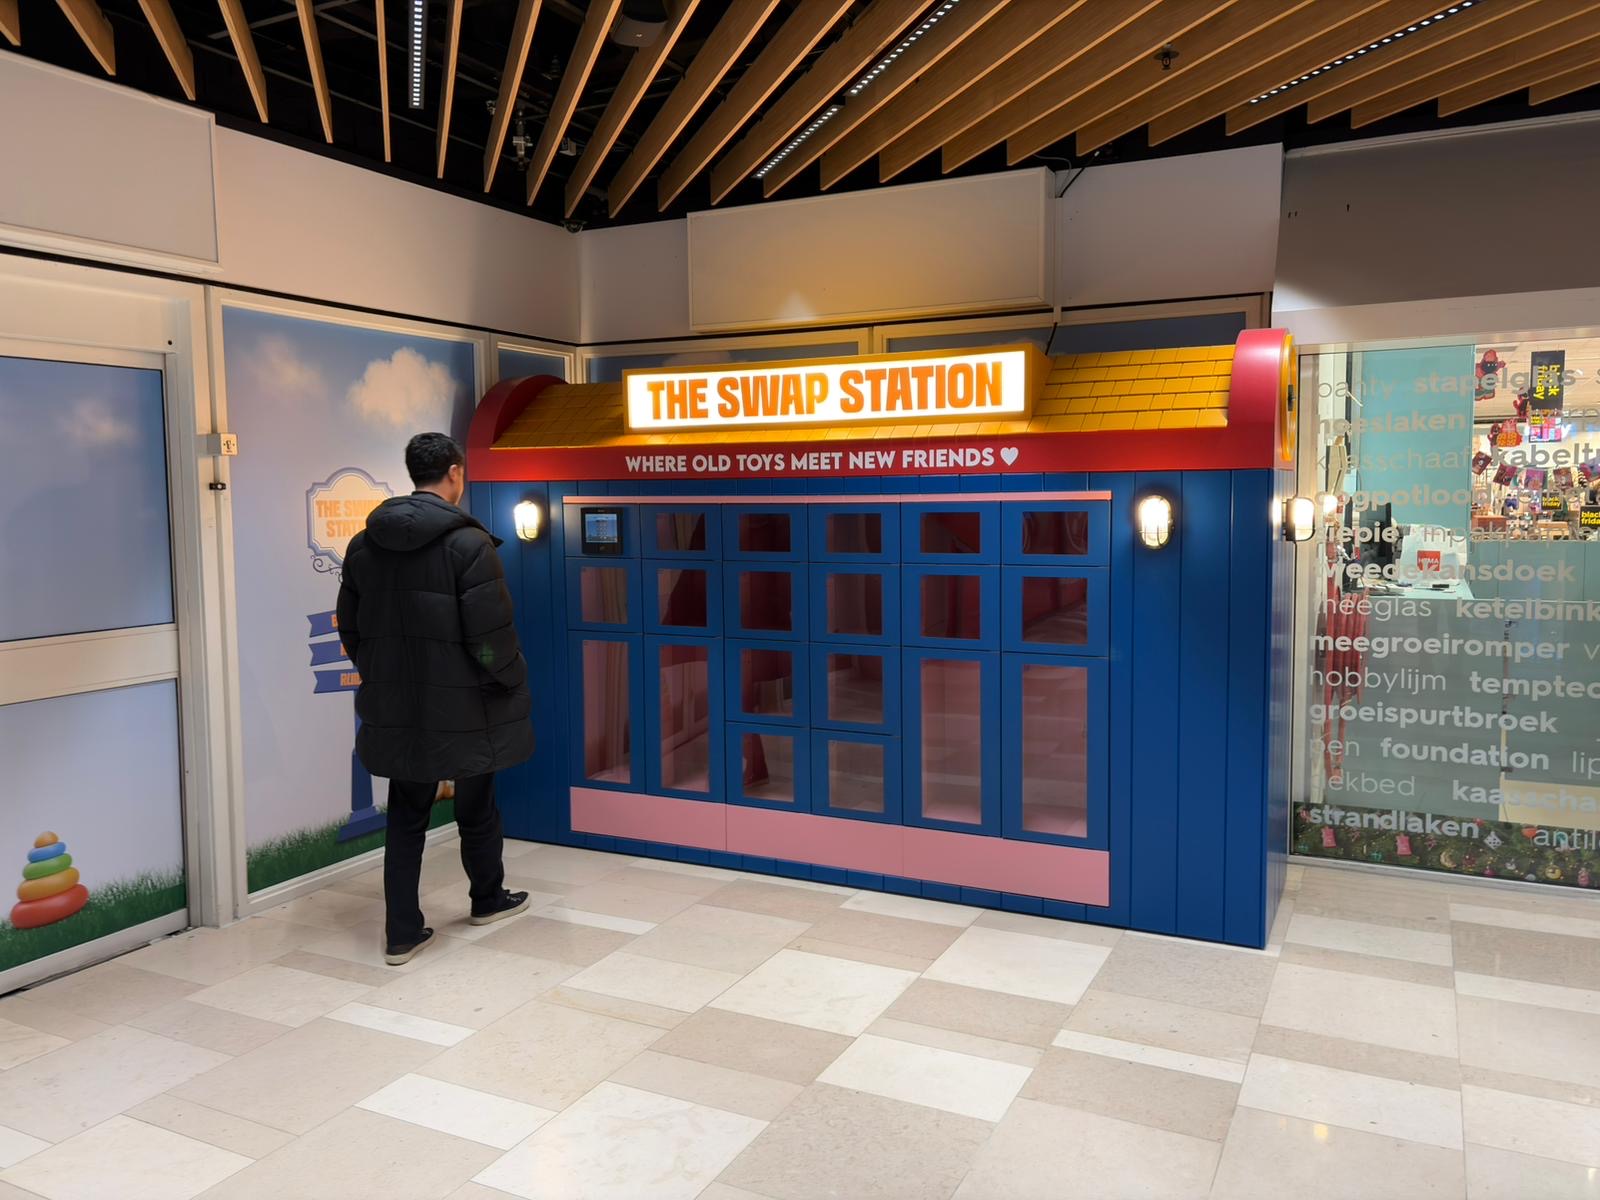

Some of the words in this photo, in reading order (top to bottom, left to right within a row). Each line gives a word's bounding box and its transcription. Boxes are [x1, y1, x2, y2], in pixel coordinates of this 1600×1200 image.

[647, 379, 708, 420] THE
[716, 372, 829, 418] SWAP
[839, 361, 1002, 413] STATION
[625, 455, 687, 473] WHERE
[692, 454, 730, 473] OLD
[736, 453, 785, 472] TOYS
[790, 451, 843, 470] MEET
[848, 450, 896, 470] NEW
[902, 447, 995, 469] FRIENDS
[316, 500, 341, 518] THE
[1310, 633, 1570, 663] meegroeiromper
[1309, 665, 1446, 694] hobbylijm
[1309, 701, 1558, 733] groeispurtbroek
[1380, 737, 1549, 770] foundation
[1309, 804, 1480, 839] strandlaken
